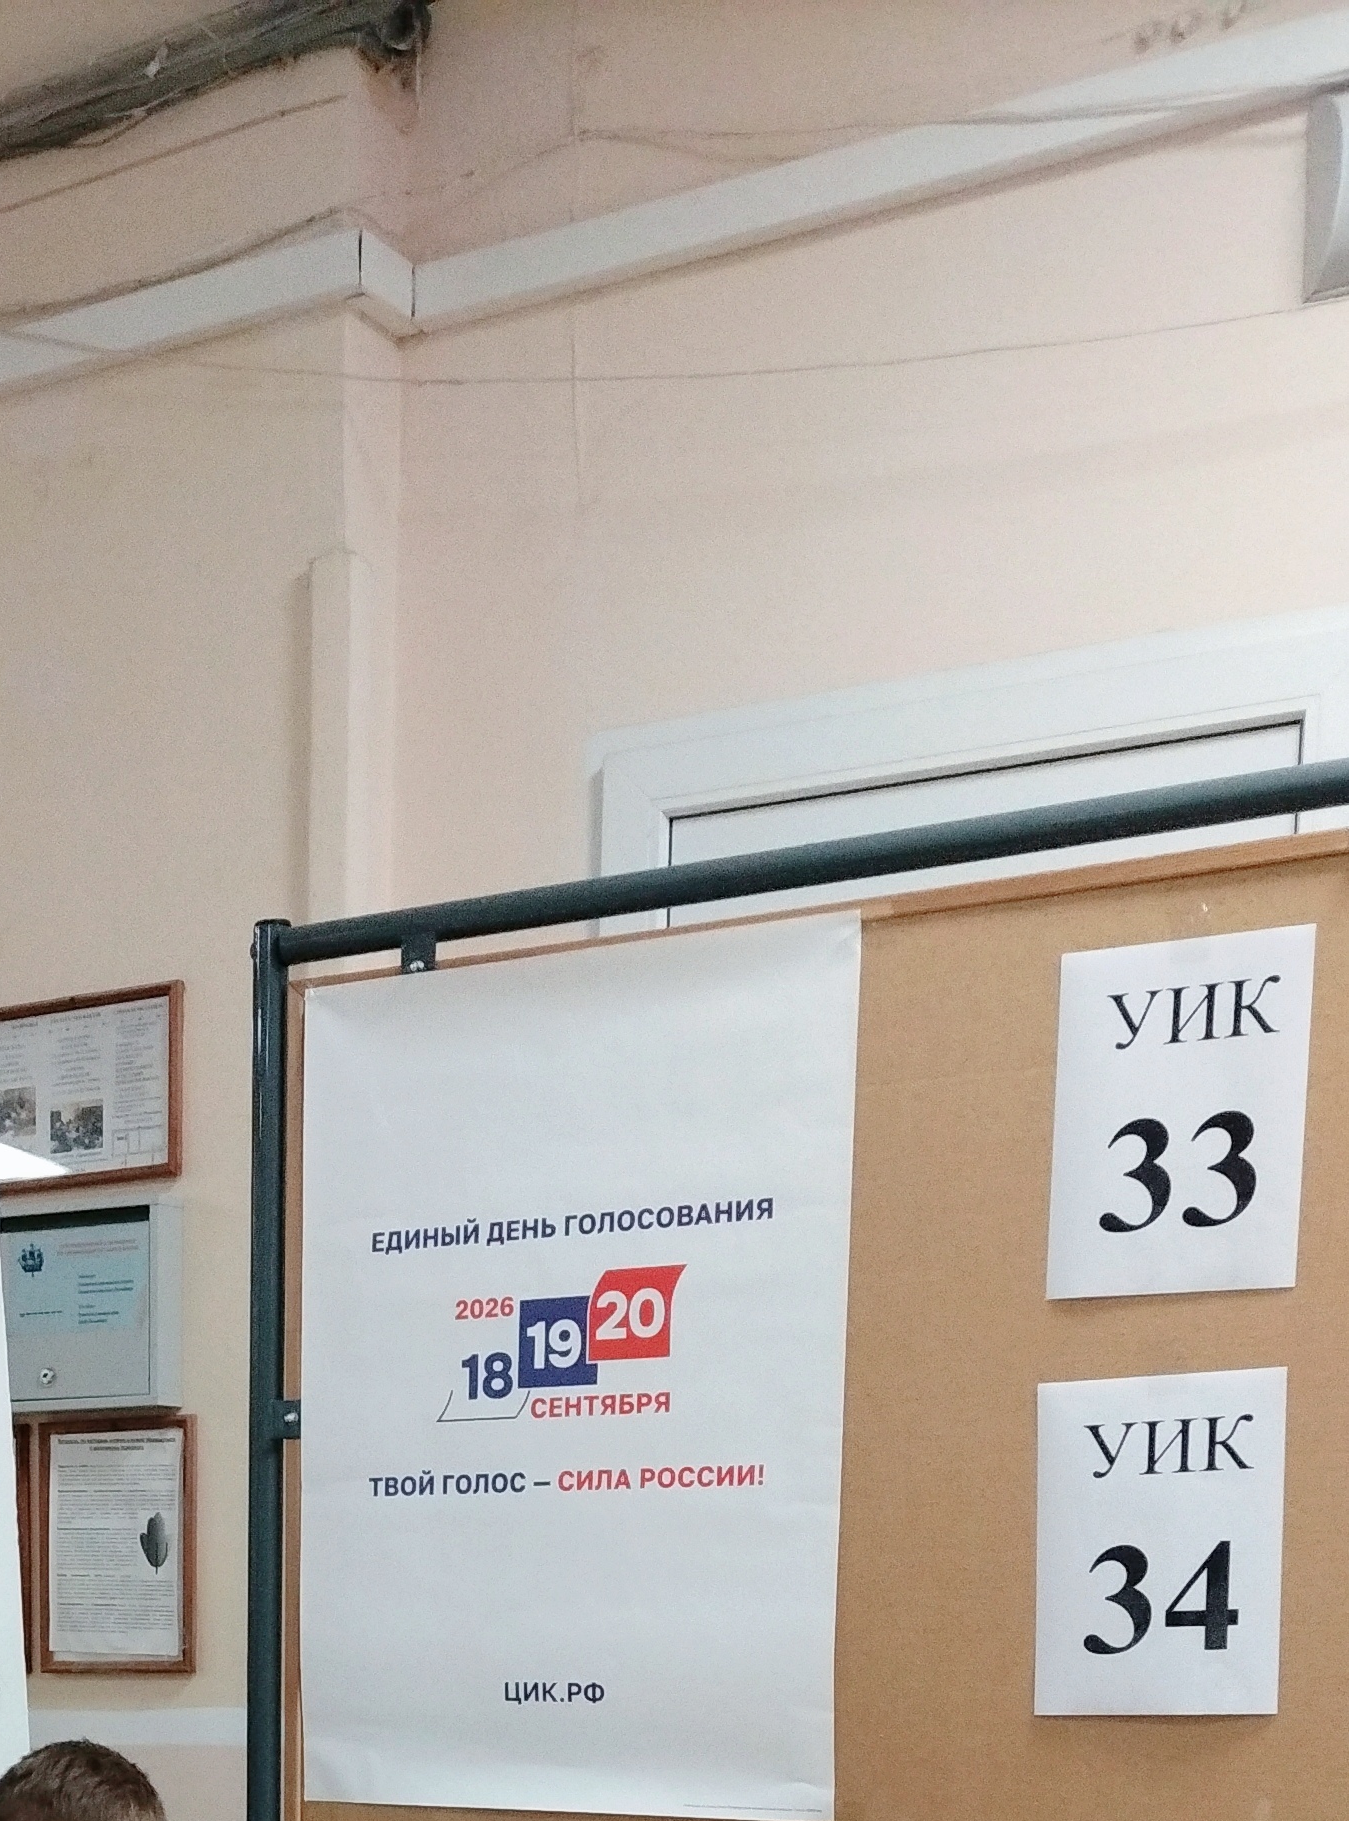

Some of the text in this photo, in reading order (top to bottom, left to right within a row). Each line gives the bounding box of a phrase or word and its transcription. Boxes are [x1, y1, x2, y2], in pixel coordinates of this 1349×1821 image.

[1108, 975, 1281, 1050] УИК
[1098, 1110, 1257, 1233] 33
[371, 1197, 774, 1255] ЕДИНЫЙ ДЕНЬ ГОЛОСОВАНИЯ
[454, 1296, 514, 1321] 2026
[460, 1287, 665, 1401] 18 19 20
[530, 1391, 671, 1419] СЕНТЯБРЯ
[1084, 1414, 1254, 1479] УИК
[368, 1470, 435, 1497] ТВОЙ
[442, 1472, 526, 1495] ГОЛОС
[557, 1468, 631, 1492] СИЛА
[639, 1464, 764, 1489] РОССИИ!
[1083, 1540, 1239, 1655] 34
[504, 1681, 605, 1705] ЦИК.РФ
